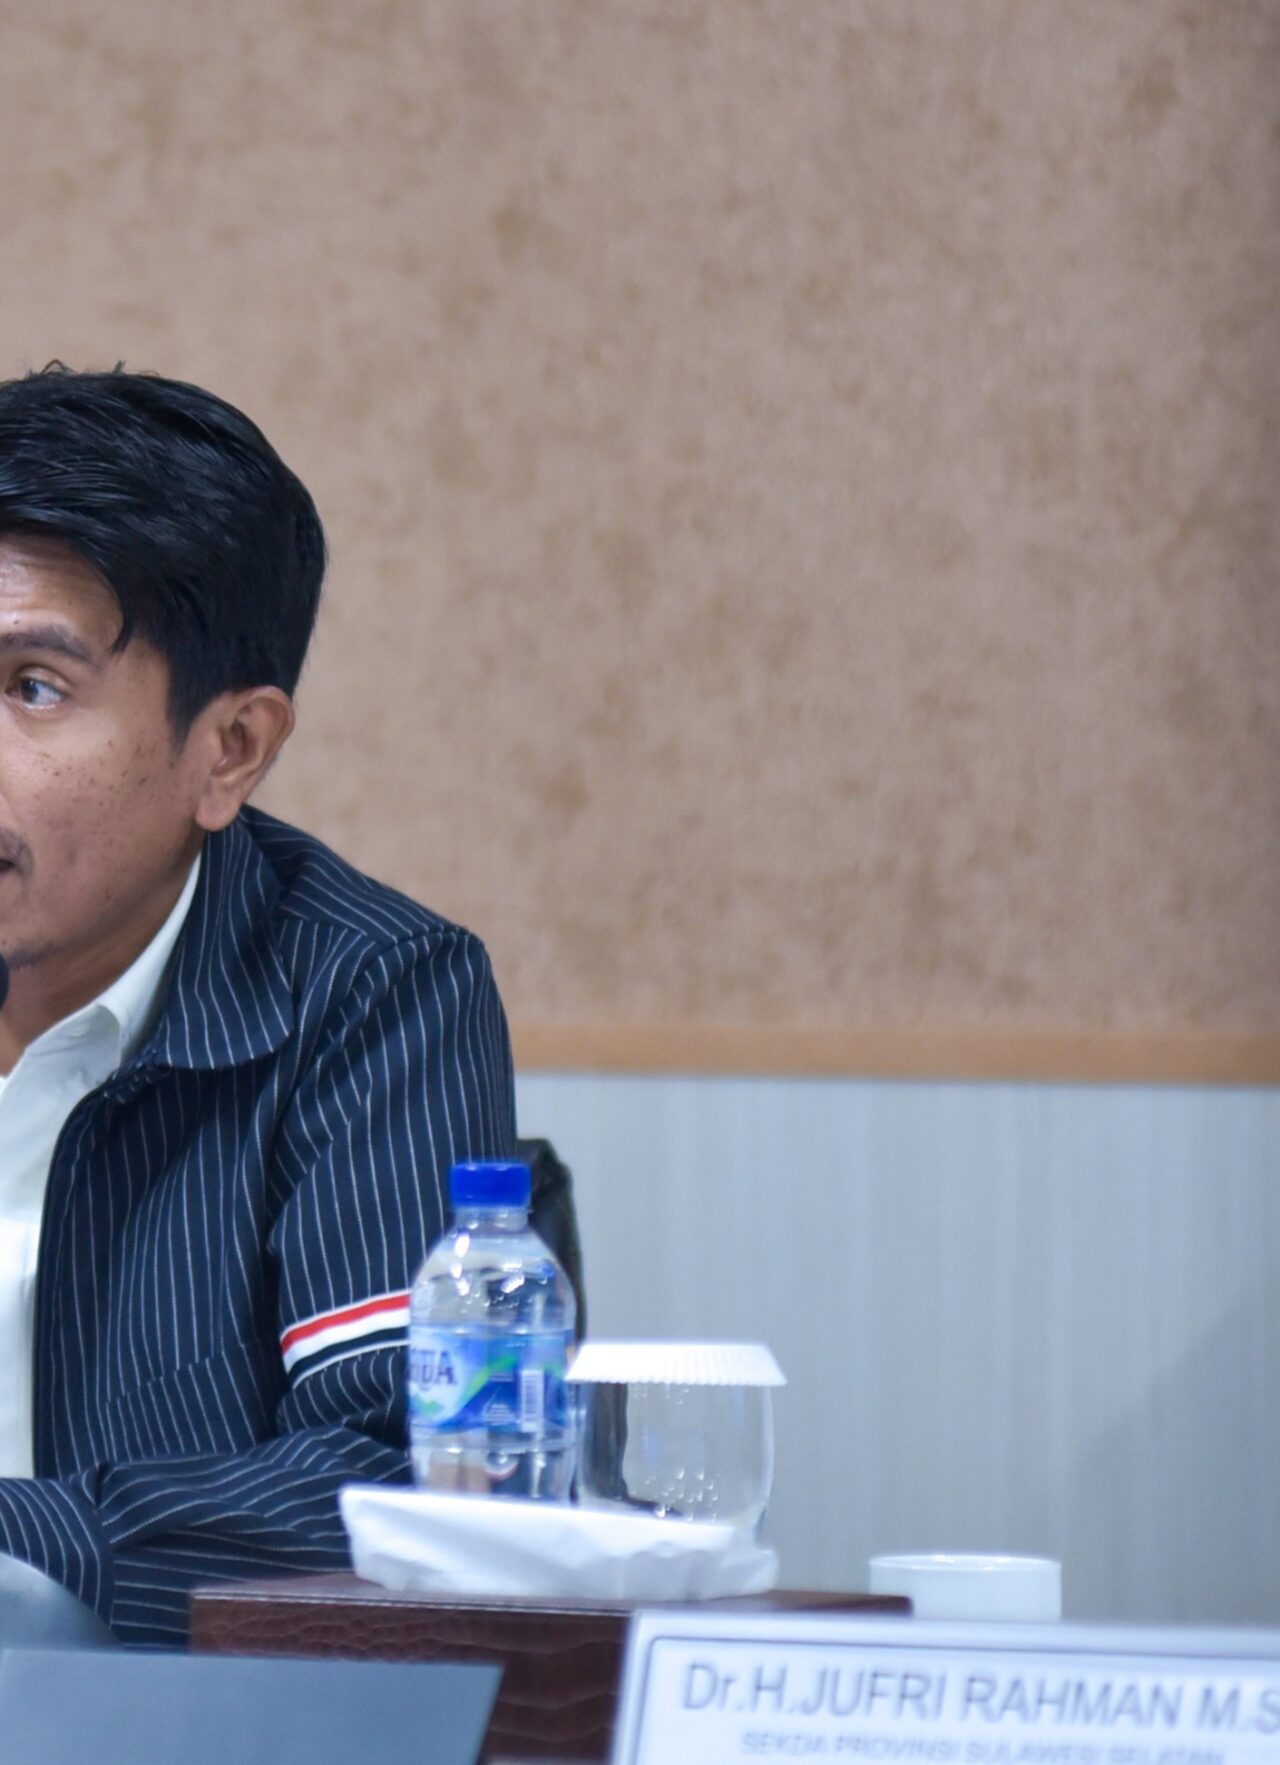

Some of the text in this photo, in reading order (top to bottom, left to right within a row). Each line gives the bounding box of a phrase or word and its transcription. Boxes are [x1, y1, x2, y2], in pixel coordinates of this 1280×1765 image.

[681, 1659, 949, 1721] Dr.H.JUFRI
[959, 1672, 1185, 1729] RAHMAN
[740, 1730, 827, 1755] SEKDA
[833, 1732, 960, 1762] PROVINSI
